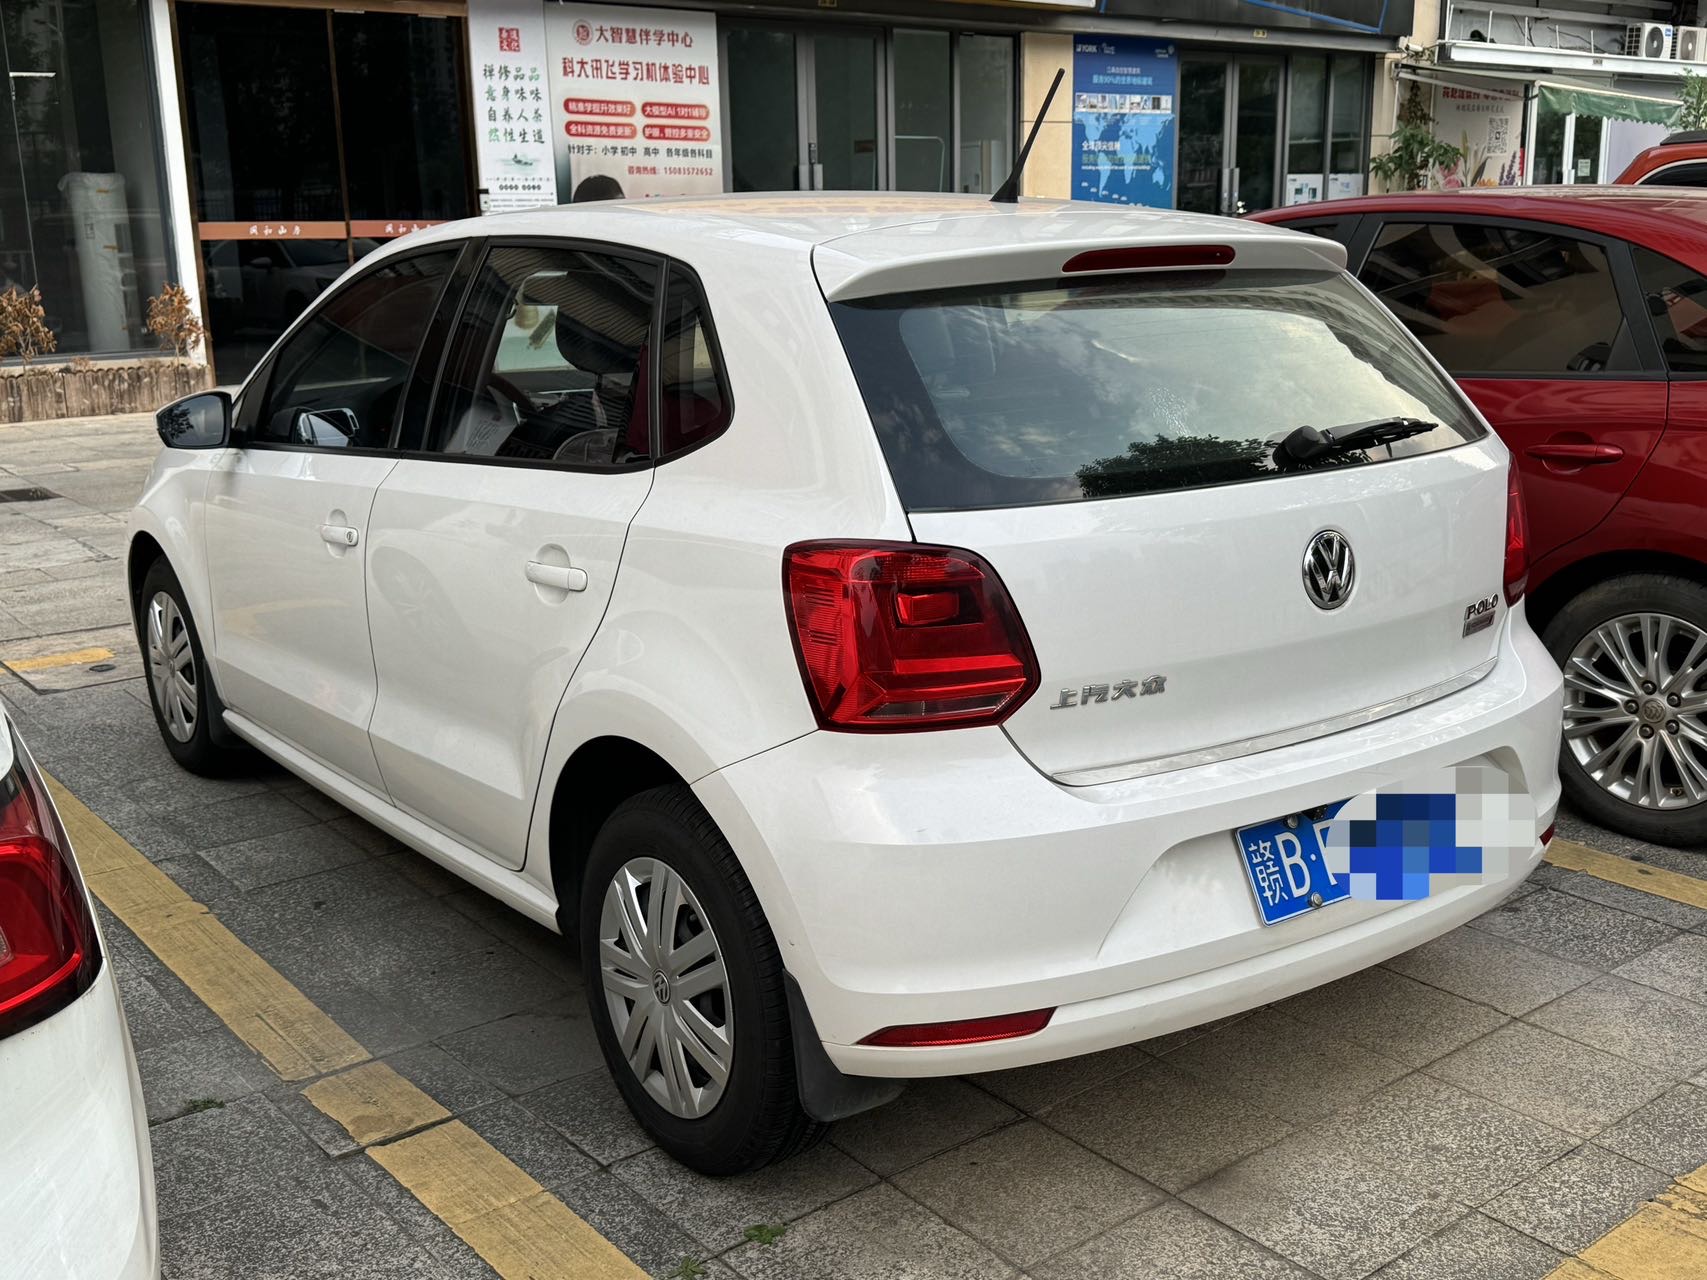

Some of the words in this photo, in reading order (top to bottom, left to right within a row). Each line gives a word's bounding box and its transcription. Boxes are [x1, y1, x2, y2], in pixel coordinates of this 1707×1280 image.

[595, 25, 693, 48] 大智慧伴学中心
[562, 57, 710, 85] 科大讯飞学习机体验中心
[601, 145, 619, 156] 小学
[643, 147, 660, 157] 高中
[1464, 593, 1499, 620] POLO
[1050, 675, 1167, 710] 上汽大众
